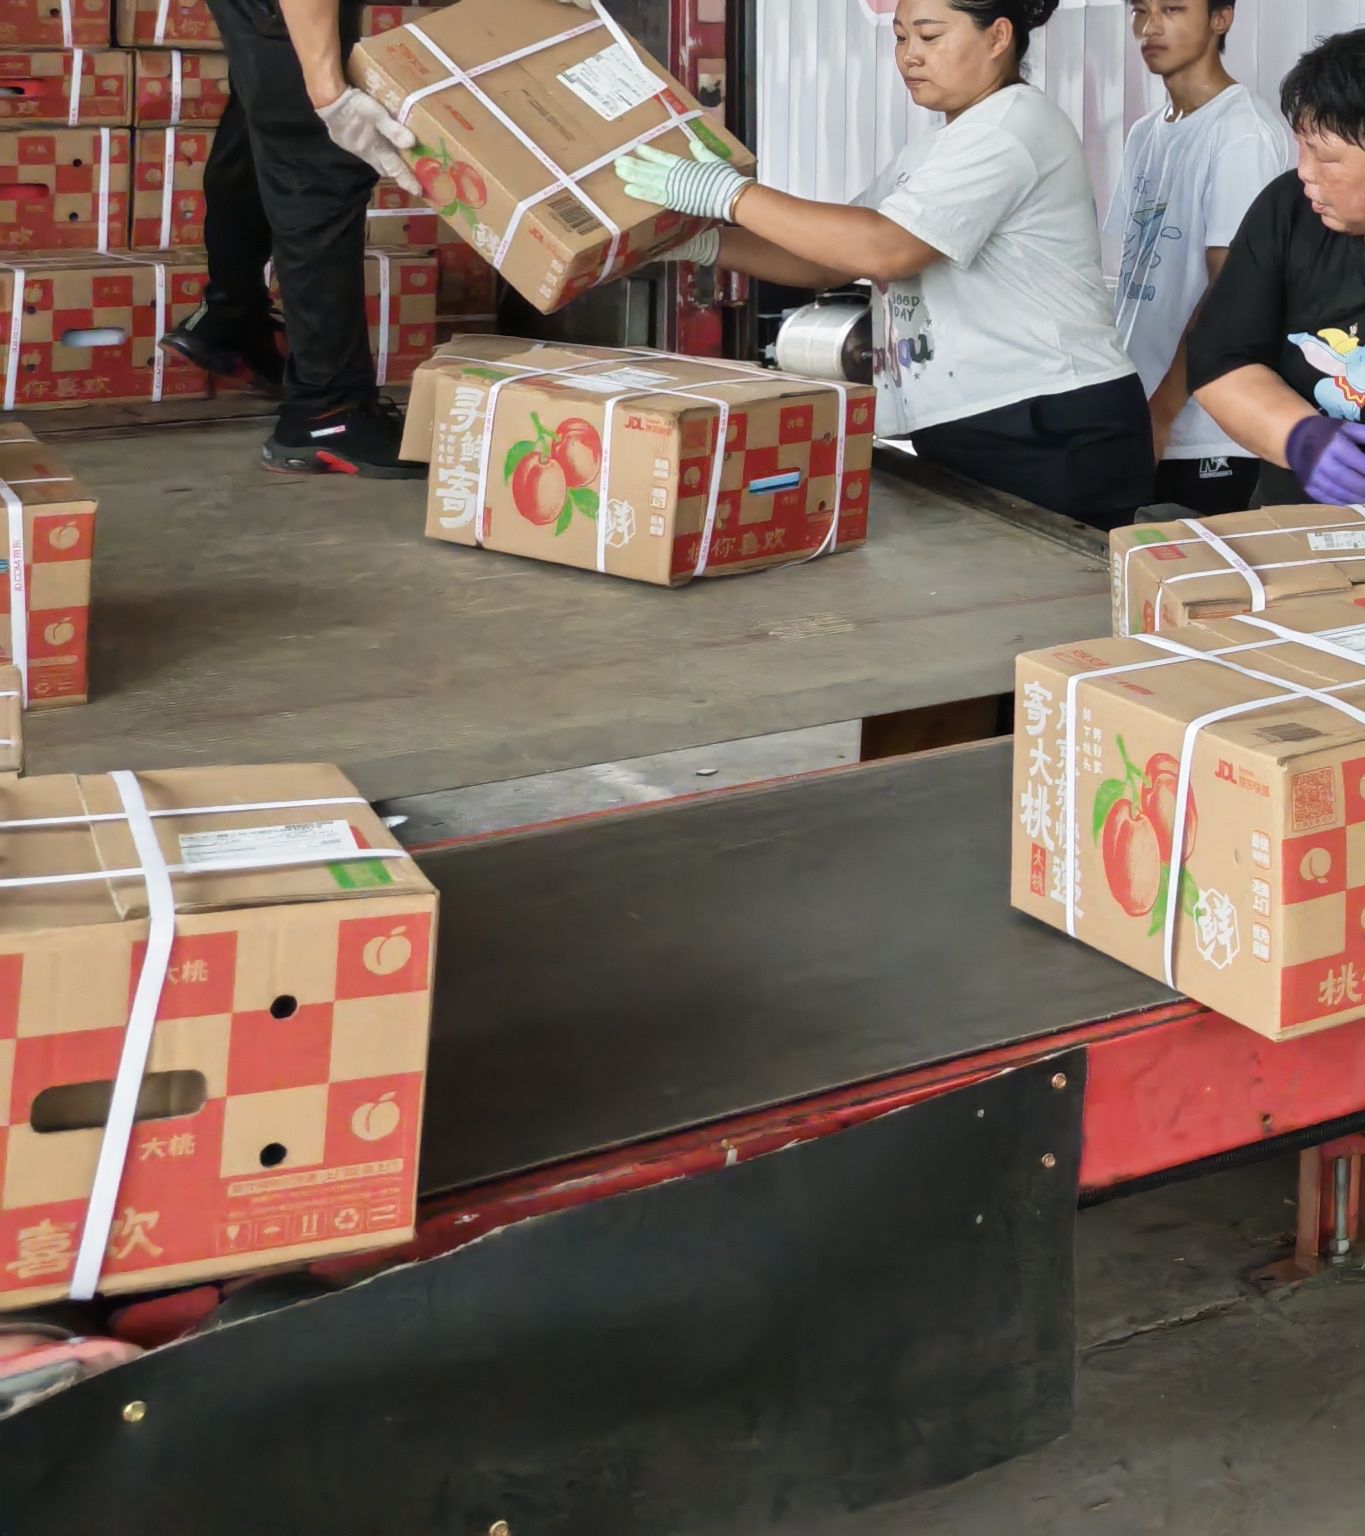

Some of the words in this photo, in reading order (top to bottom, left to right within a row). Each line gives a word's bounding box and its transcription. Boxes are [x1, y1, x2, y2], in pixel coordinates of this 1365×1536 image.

[1020, 680, 1055, 852] 寄大桃
[1215, 758, 1238, 784] JDL
[140, 1133, 196, 1161] 大桃
